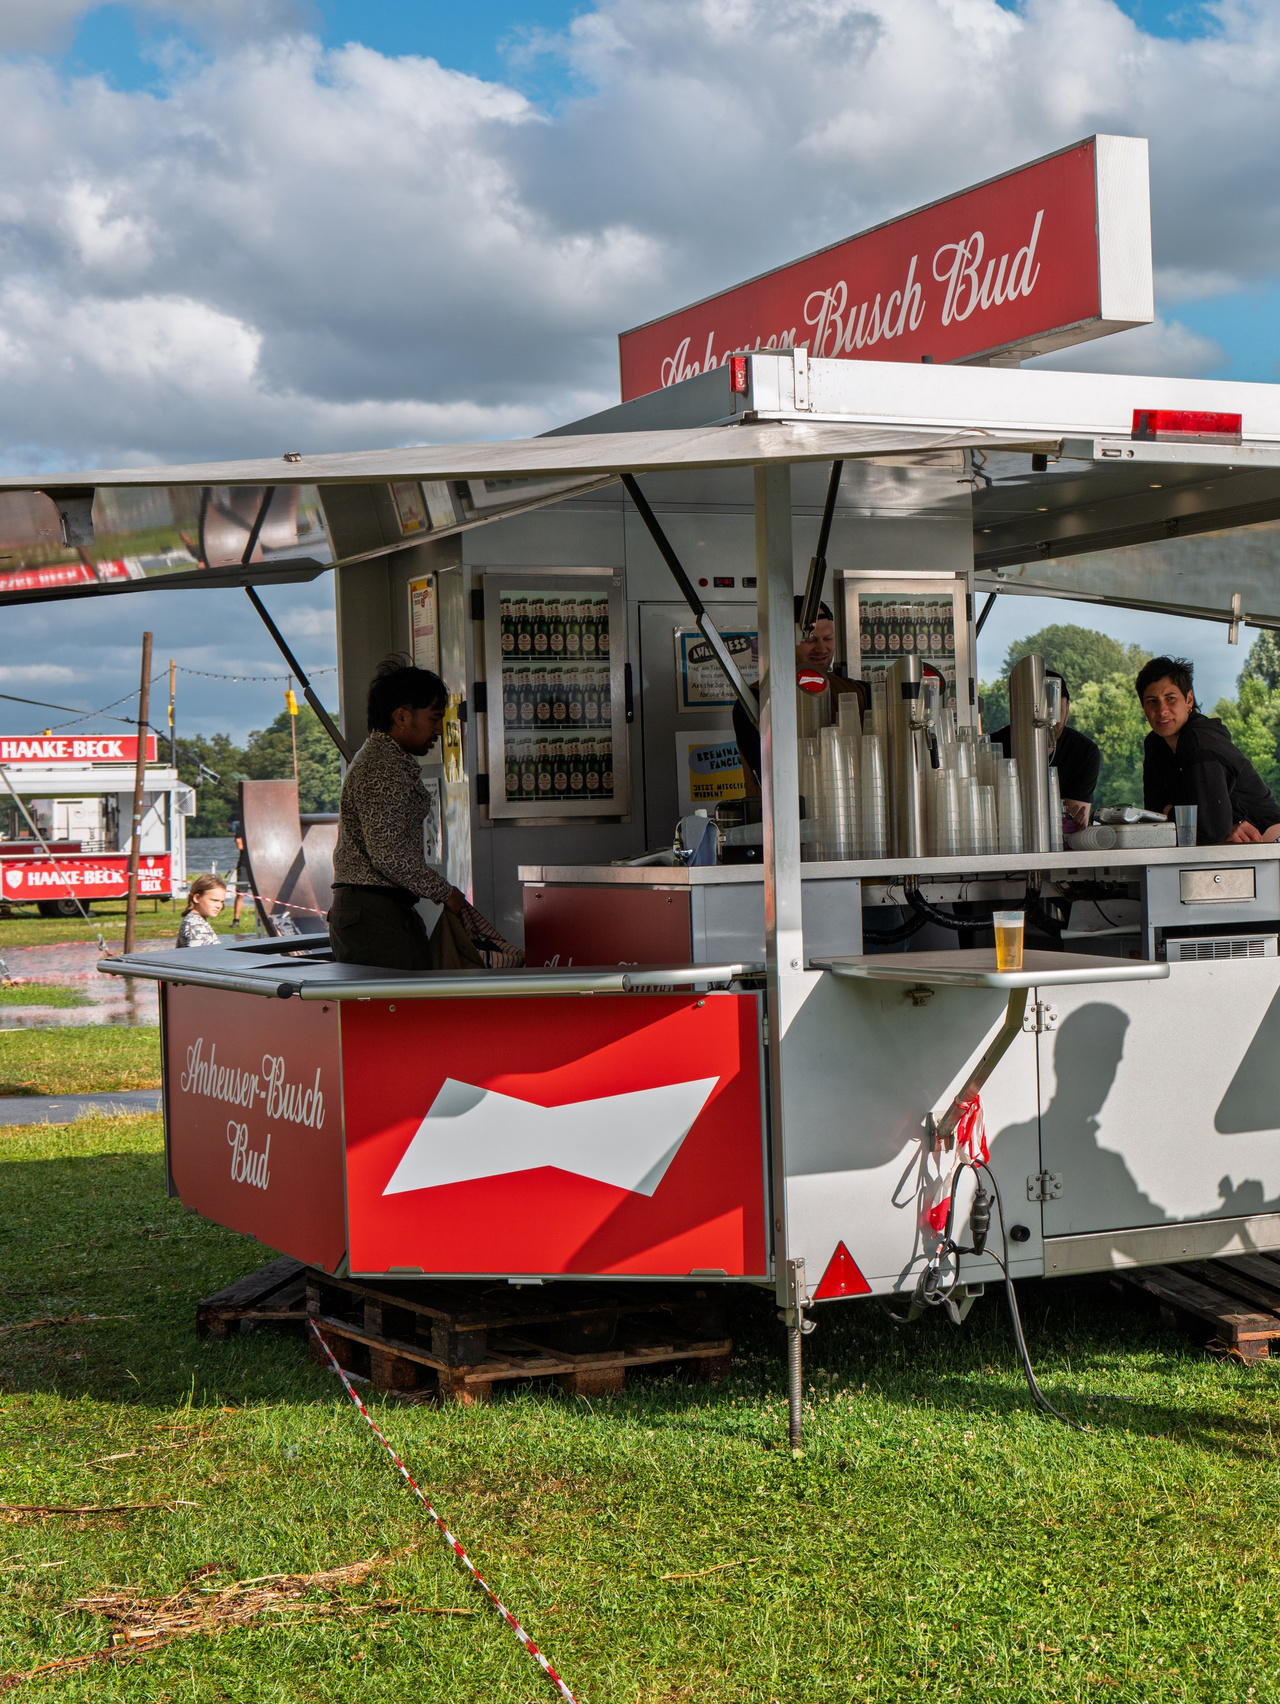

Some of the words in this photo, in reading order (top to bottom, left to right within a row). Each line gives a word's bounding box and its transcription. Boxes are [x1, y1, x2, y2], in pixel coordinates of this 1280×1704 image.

[931, 209, 1045, 327] Bud
[1, 740, 124, 759] HAAKE-BECK
[697, 747, 739, 762] BREMINA
[694, 790, 723, 798] WERDEN!
[717, 782, 744, 791] MITGLIE
[27, 870, 125, 886] HAAKE-BECK
[137, 868, 164, 880] HAAKE
[141, 880, 162, 892] BECK
[180, 1036, 326, 1130] Anheuser-Busch
[225, 1119, 272, 1191] Bud
